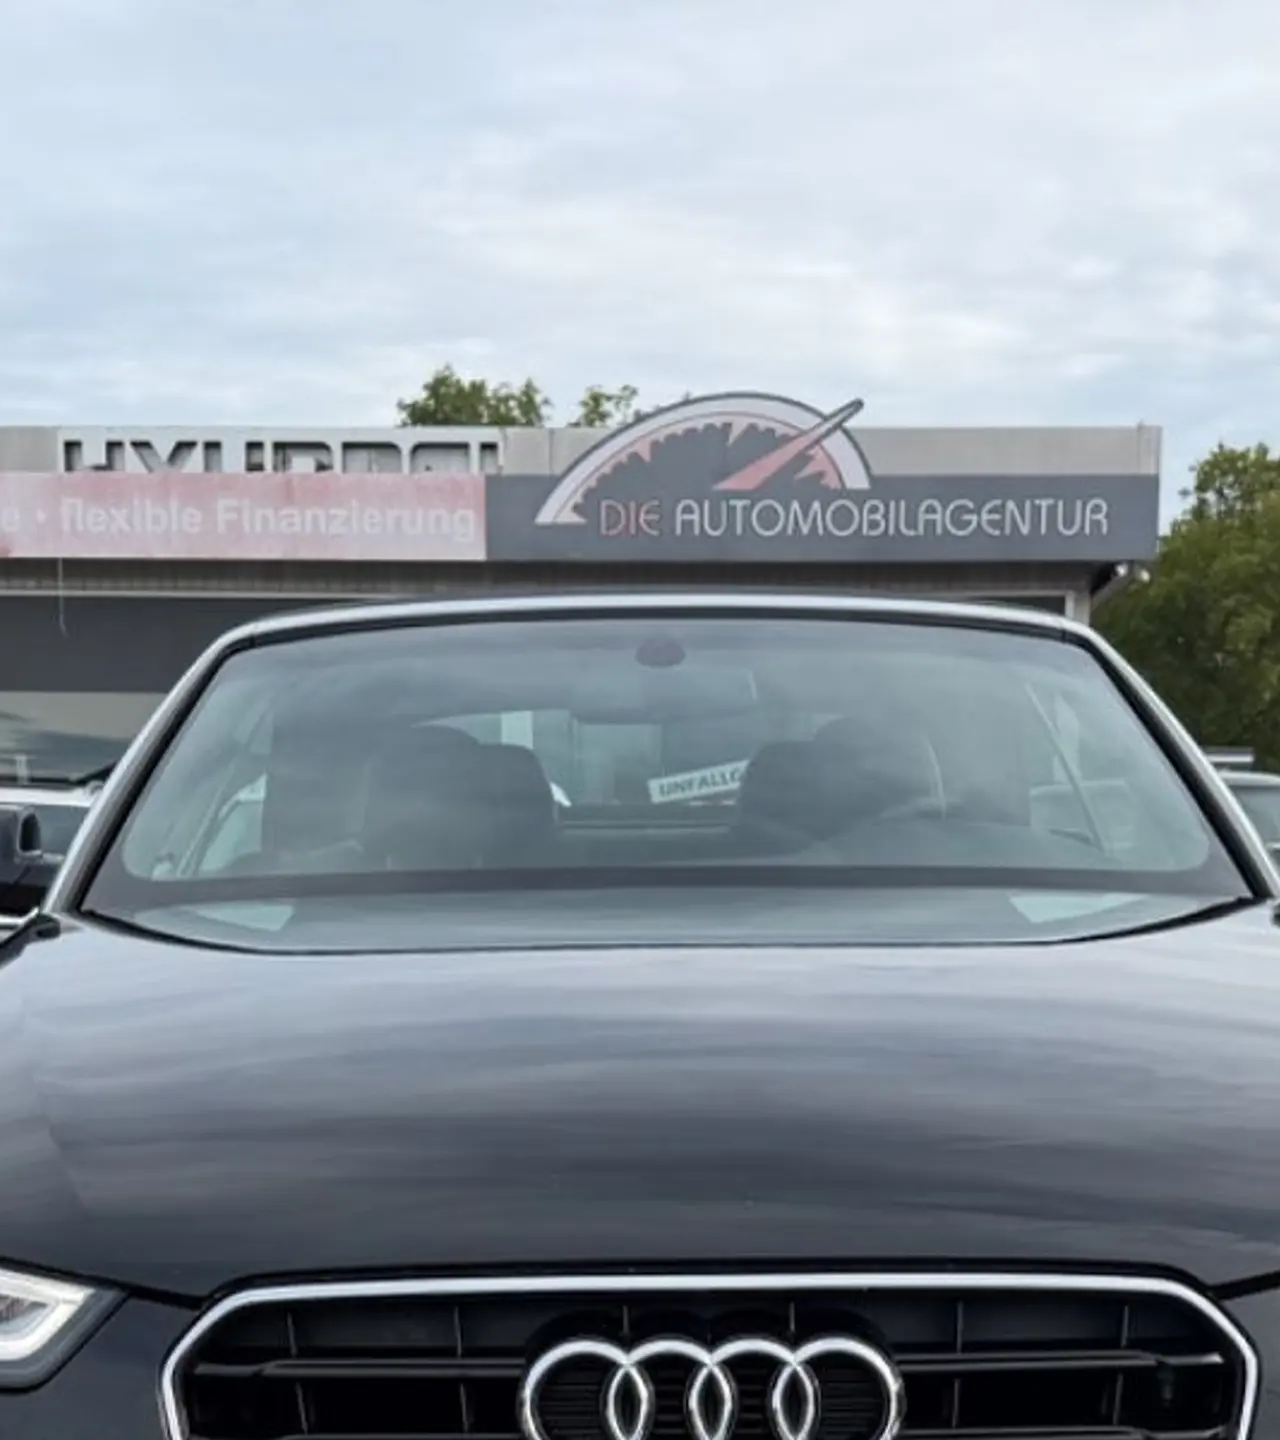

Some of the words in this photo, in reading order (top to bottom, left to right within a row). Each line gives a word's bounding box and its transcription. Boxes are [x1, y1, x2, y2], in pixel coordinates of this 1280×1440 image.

[60, 498, 203, 535] flexible
[217, 500, 476, 542] Finanzierung
[600, 500, 660, 536] DIE
[675, 499, 1109, 536] AUTOMOBILAGENTUR
